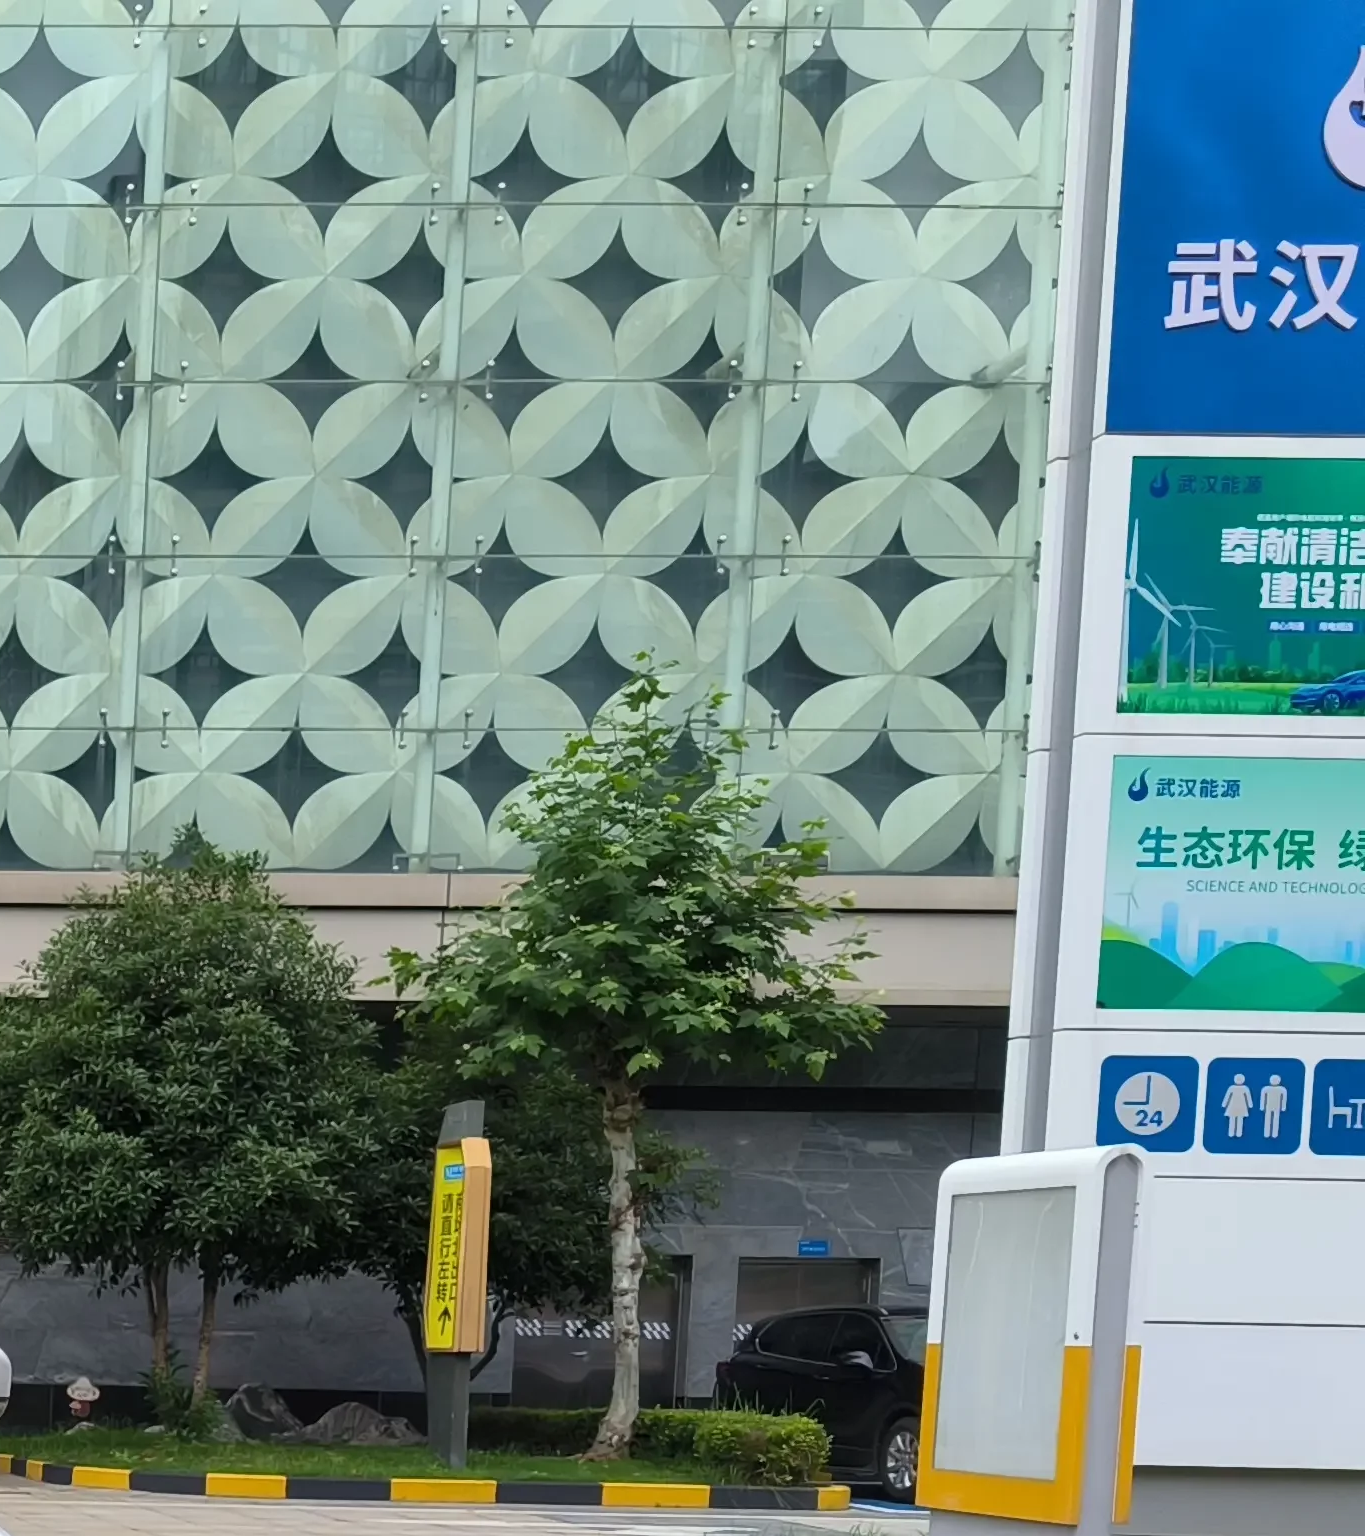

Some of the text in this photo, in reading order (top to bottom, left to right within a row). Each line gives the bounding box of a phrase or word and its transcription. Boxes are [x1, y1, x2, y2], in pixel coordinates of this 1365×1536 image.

[1164, 238, 1359, 332] 武汉
[1177, 474, 1263, 495] 武汉能源
[1155, 778, 1241, 799] 武汉能源
[1136, 826, 1315, 870] 生态环保
[1186, 880, 1245, 893] SCIENCE
[1249, 881, 1278, 893] AND
[1135, 1109, 1164, 1128] 24
